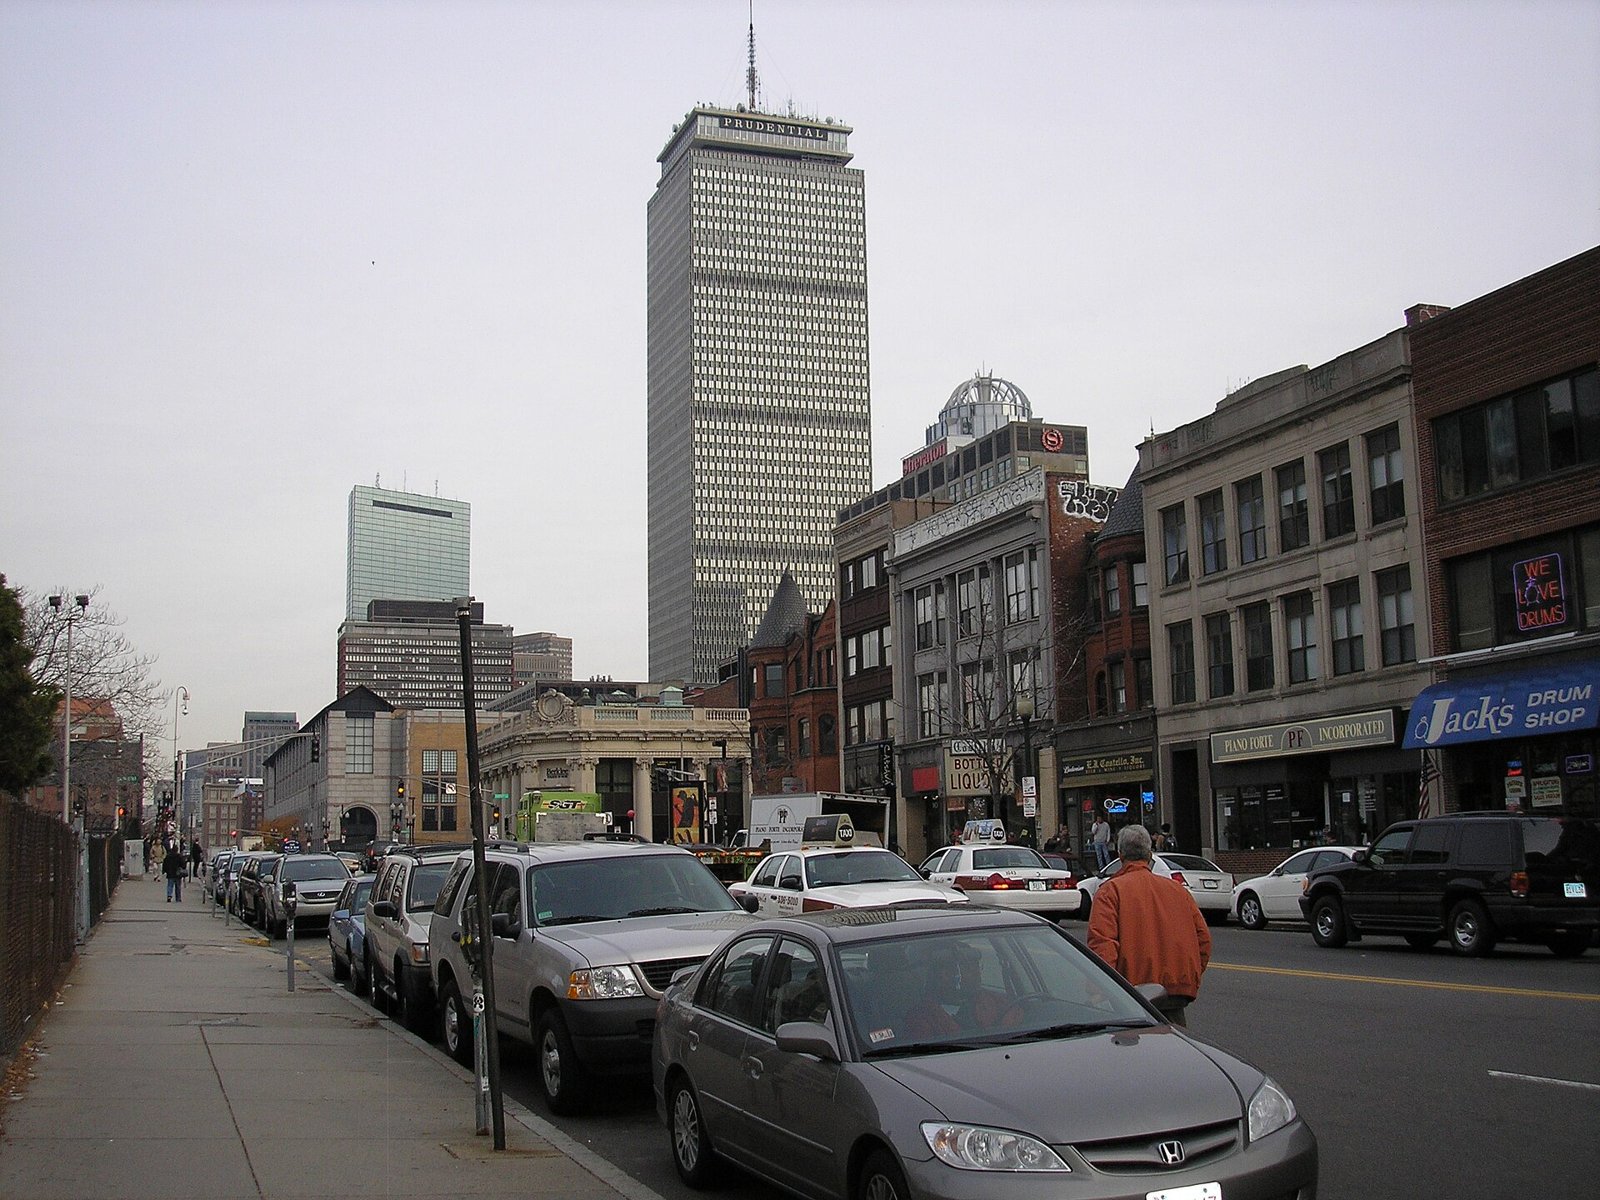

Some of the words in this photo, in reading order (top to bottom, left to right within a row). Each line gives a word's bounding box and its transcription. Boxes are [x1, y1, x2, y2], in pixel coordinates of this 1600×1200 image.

[724, 117, 824, 138] PRUDENTIAL
[903, 444, 946, 474] Sheraton
[1524, 558, 1551, 577] WE
[1520, 605, 1564, 628] DRUMS
[1527, 684, 1592, 707] DRUM
[1425, 695, 1515, 744] Jack's
[1524, 707, 1585, 729] SHOP
[1224, 738, 1248, 753] PIANO
[1249, 734, 1274, 750] FORTE
[1288, 730, 1304, 748] PF
[1319, 719, 1385, 742] INCORPORATED
[950, 772, 1009, 790] LIQUOS
